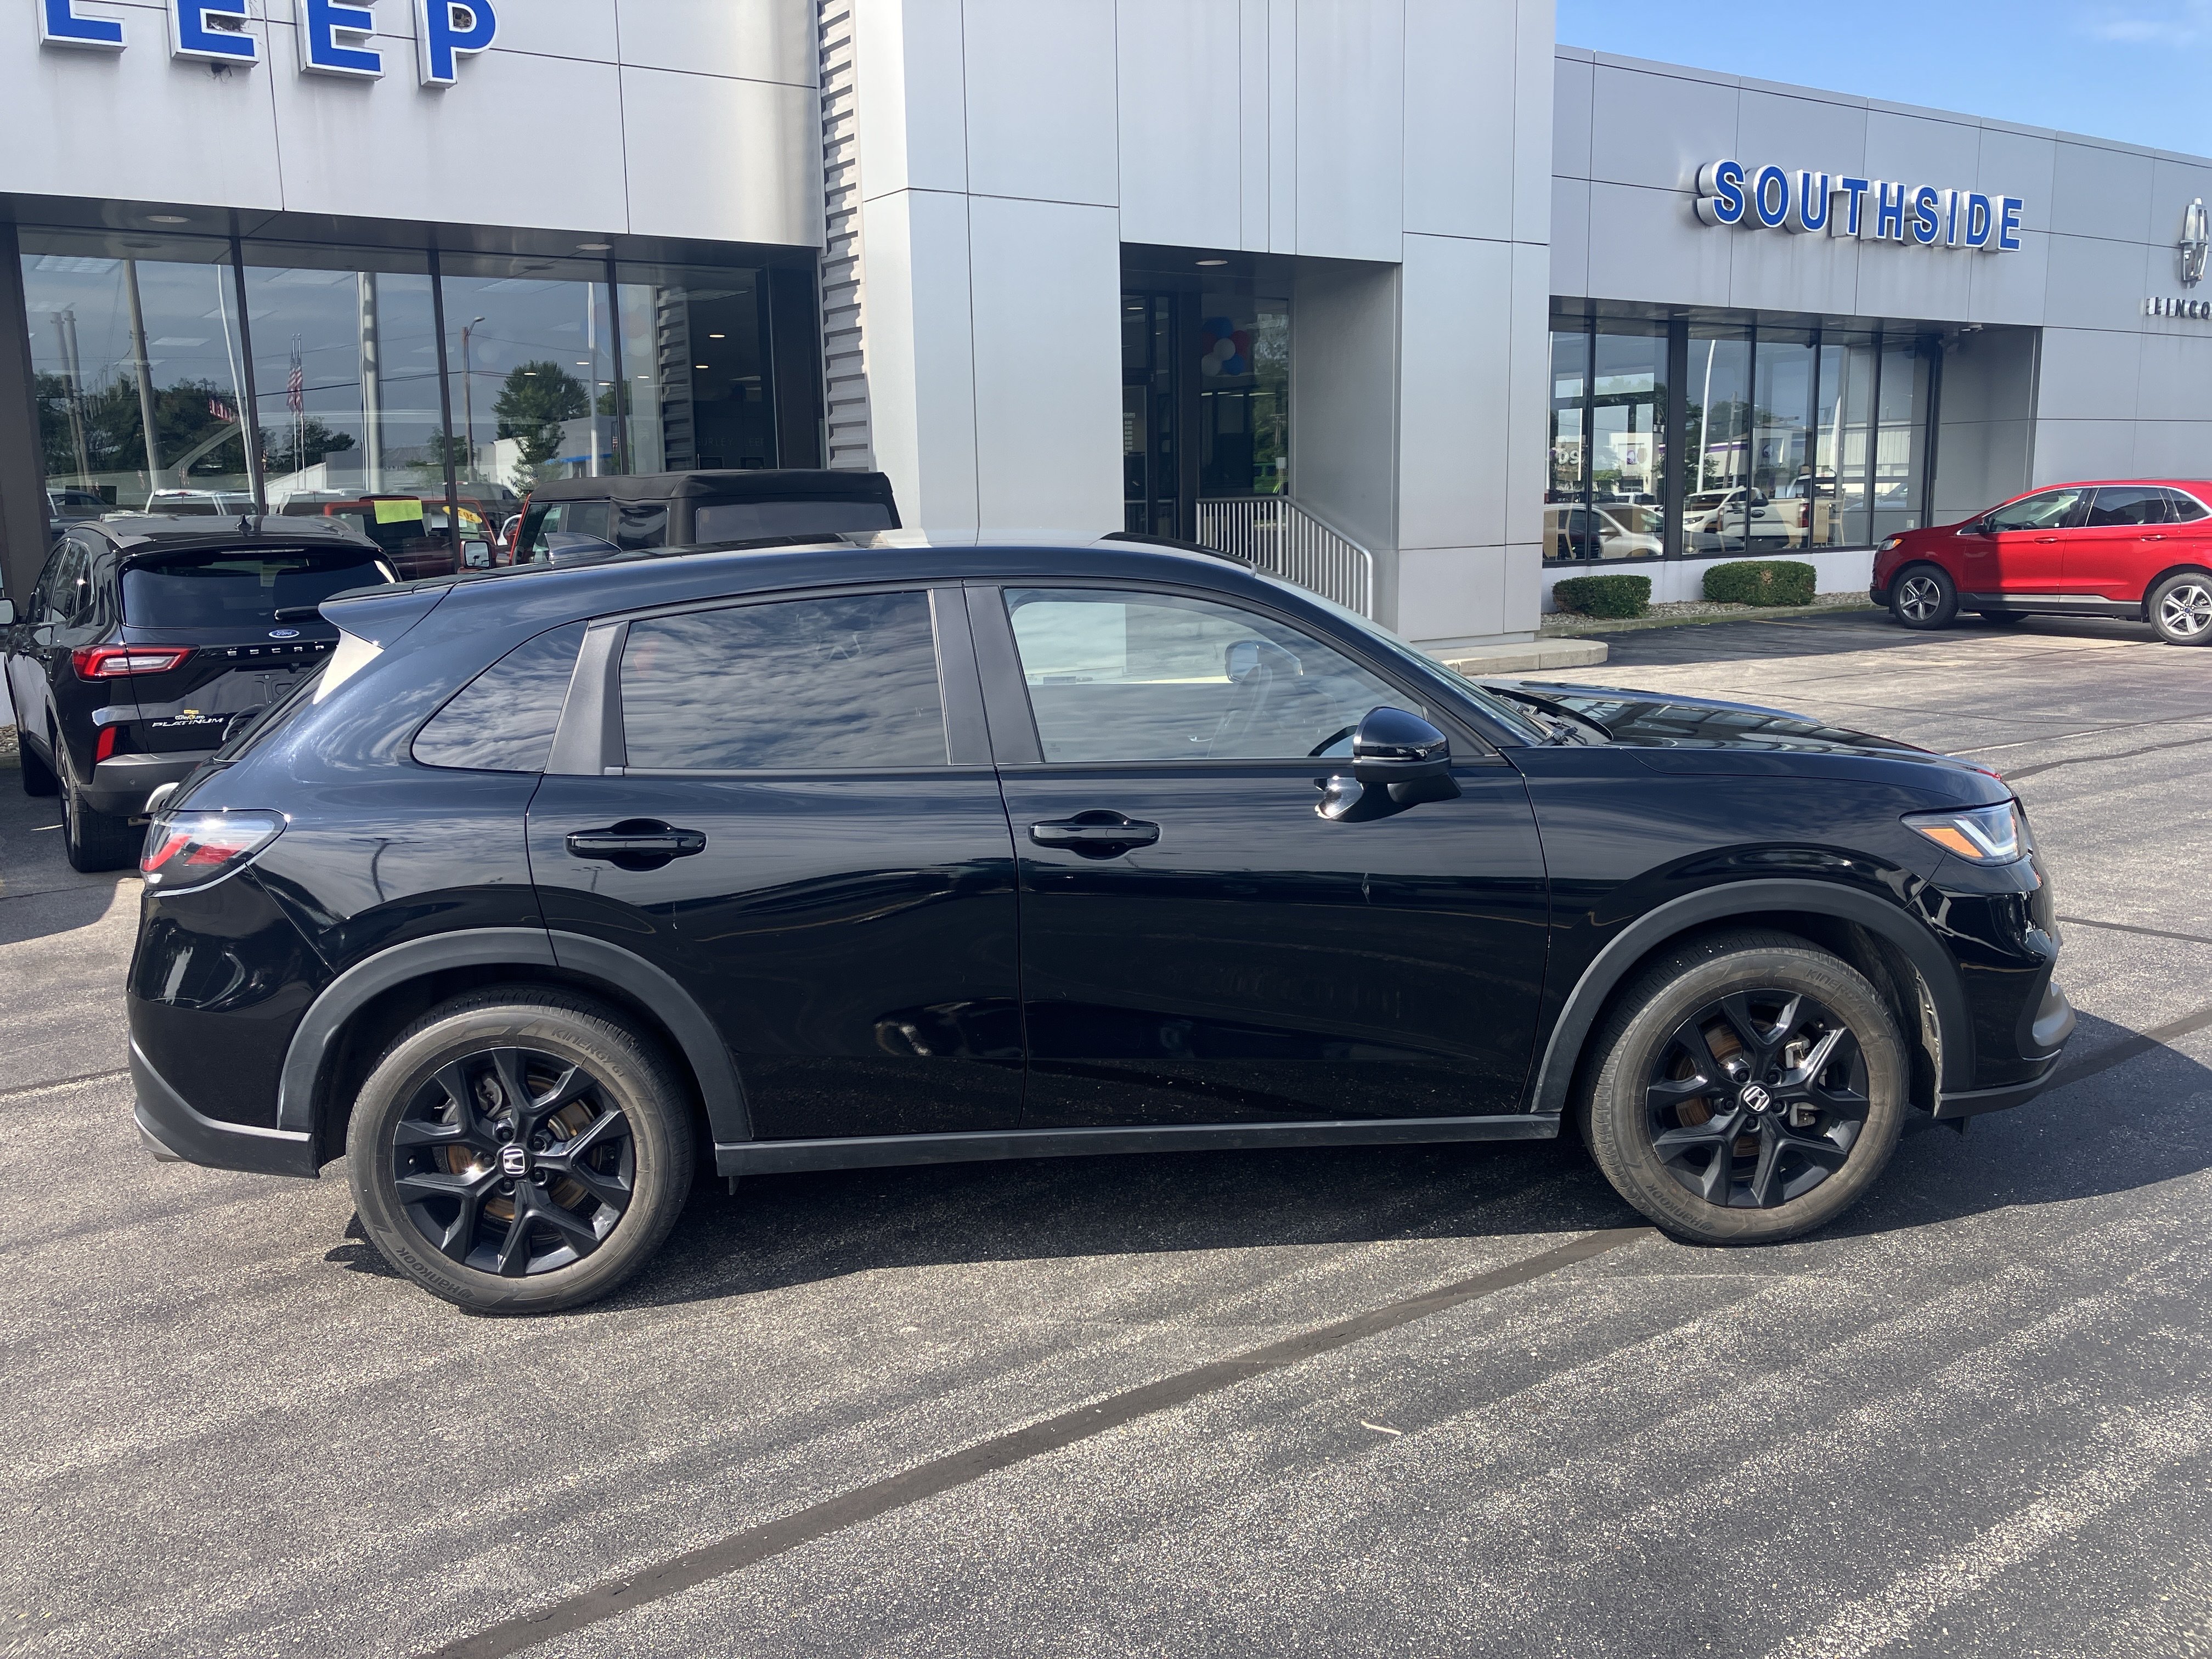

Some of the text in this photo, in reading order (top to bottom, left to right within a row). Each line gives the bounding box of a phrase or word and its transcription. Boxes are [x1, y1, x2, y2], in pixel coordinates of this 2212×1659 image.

[1703, 159, 2024, 252] SOUTHSIDE
[227, 641, 326, 657] ESCAP
[151, 717, 224, 727] PLATINUM
